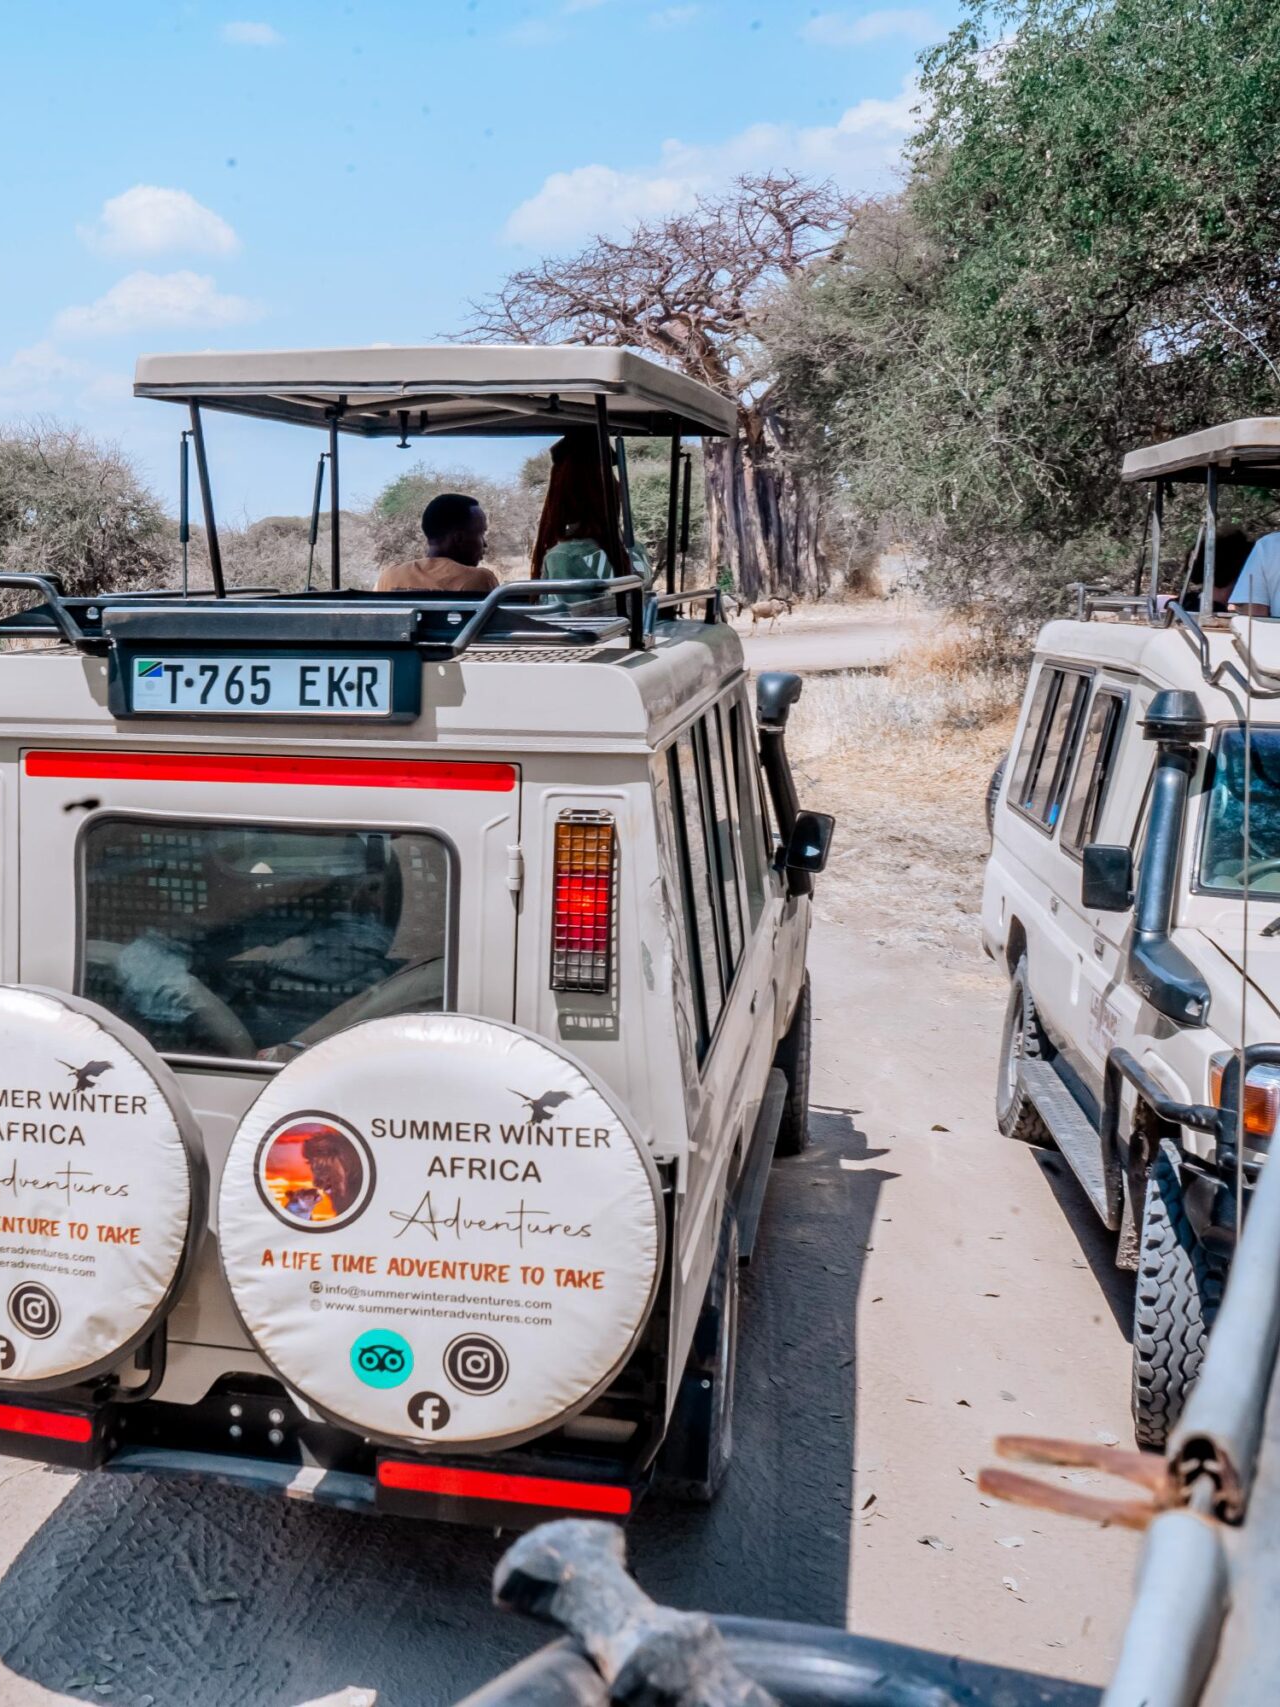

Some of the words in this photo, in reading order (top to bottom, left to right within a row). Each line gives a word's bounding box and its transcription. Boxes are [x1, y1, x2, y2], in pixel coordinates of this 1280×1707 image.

[199, 665, 271, 706] 765
[299, 666, 379, 707] EKR
[49, 1090, 148, 1115] WINTER
[371, 1118, 491, 1144] SUMMER
[499, 1123, 611, 1149] WINTER
[427, 1155, 542, 1183] AFRICA
[68, 1221, 89, 1241] TO
[96, 1224, 141, 1245] TAKE
[389, 1190, 593, 1249] Adventures
[260, 1248, 274, 1267] A
[281, 1250, 322, 1271] LIFE
[331, 1253, 377, 1275] TIME
[387, 1257, 511, 1284] ADVENTURE
[520, 1266, 545, 1287] TO
[554, 1267, 605, 1291] TAKE
[324, 1283, 552, 1311] info@summerwinteradventures.com
[324, 1300, 552, 1326] www.summerwinteradventures.com
